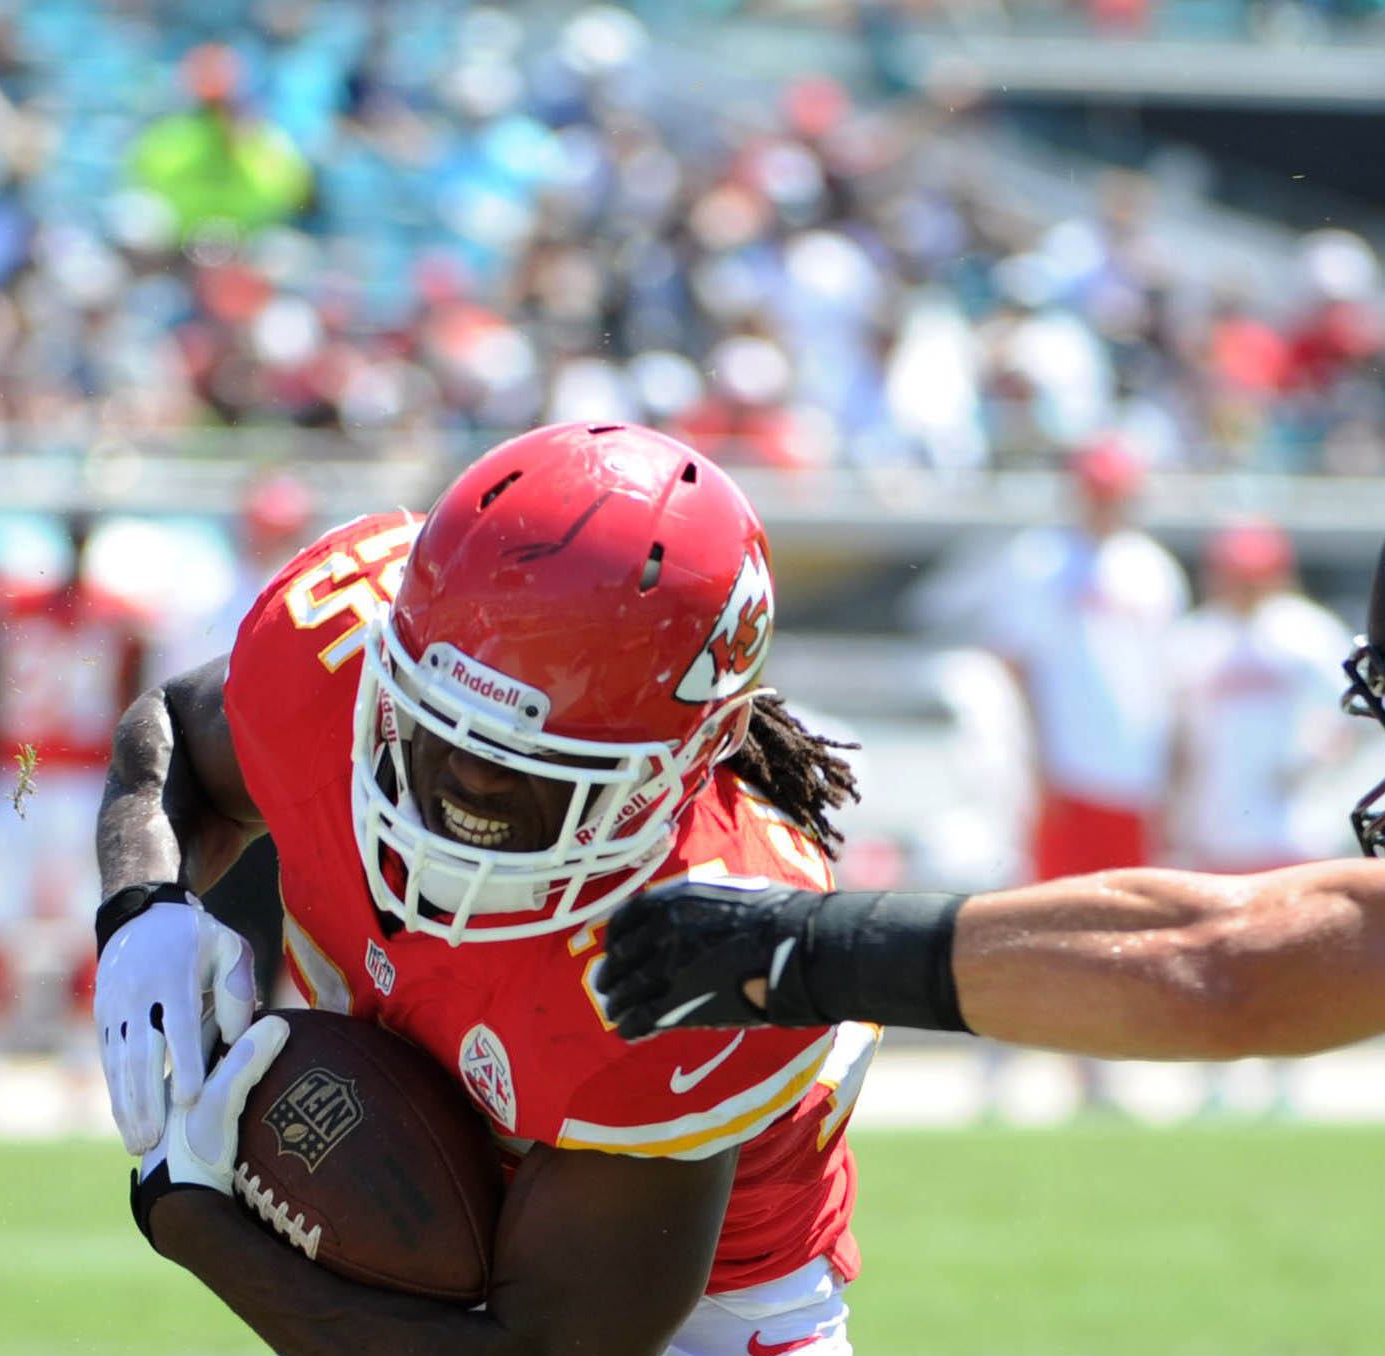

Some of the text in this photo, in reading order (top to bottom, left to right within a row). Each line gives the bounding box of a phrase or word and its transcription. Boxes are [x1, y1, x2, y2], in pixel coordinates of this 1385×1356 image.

[451, 660, 520, 707] Riddell
[575, 793, 648, 845] Rell
[288, 1074, 356, 1142] NFL
